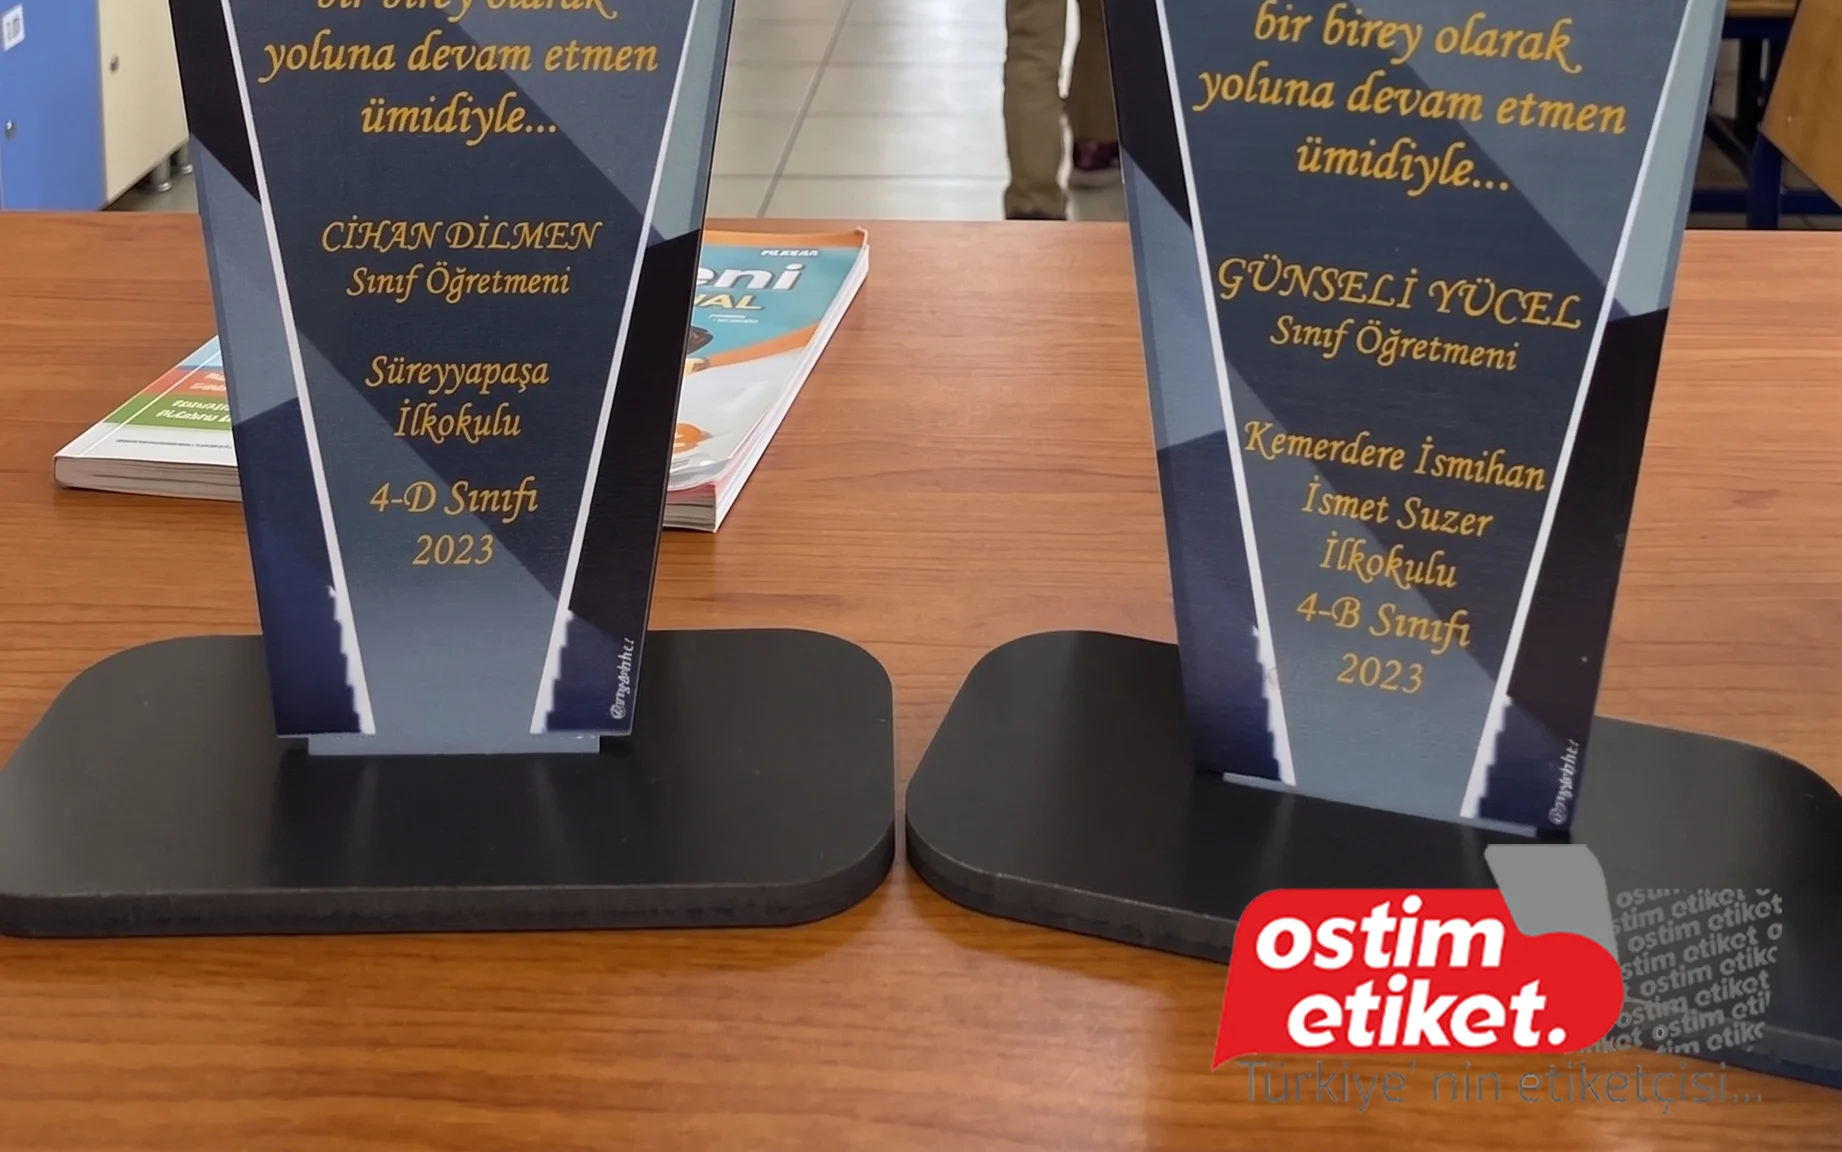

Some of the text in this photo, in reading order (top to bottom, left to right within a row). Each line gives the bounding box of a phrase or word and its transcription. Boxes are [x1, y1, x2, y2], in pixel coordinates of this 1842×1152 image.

[258, 30, 658, 82] yoluna devam etmen
[1322, 3, 1422, 64] birey
[1435, 12, 1582, 74] olarak
[361, 91, 558, 146] ümidiyle...
[1193, 61, 1627, 135] yoluna devam etmen
[1297, 135, 1509, 197] ümidiyle...
[322, 215, 603, 253] CİHAN DİLMEN
[346, 261, 571, 304] Sınıf Öğretmeni
[1218, 253, 1582, 330] GÜNSELİ YÜCEL
[1270, 315, 1520, 372] Sınıf Öğretmeni
[365, 355, 549, 395] Süreyyapaşa
[394, 398, 521, 444] İlkokulu
[1244, 420, 1547, 492] Kemerdere İsmihan
[370, 476, 538, 523] 4-D Sınıfı
[1301, 474, 1494, 537] İsmet Suzer
[412, 534, 494, 565] 2023
[1320, 531, 1457, 589] İlkokulu
[1296, 592, 1471, 655] 4-B Sınıfı
[1336, 653, 1424, 694] 2023
